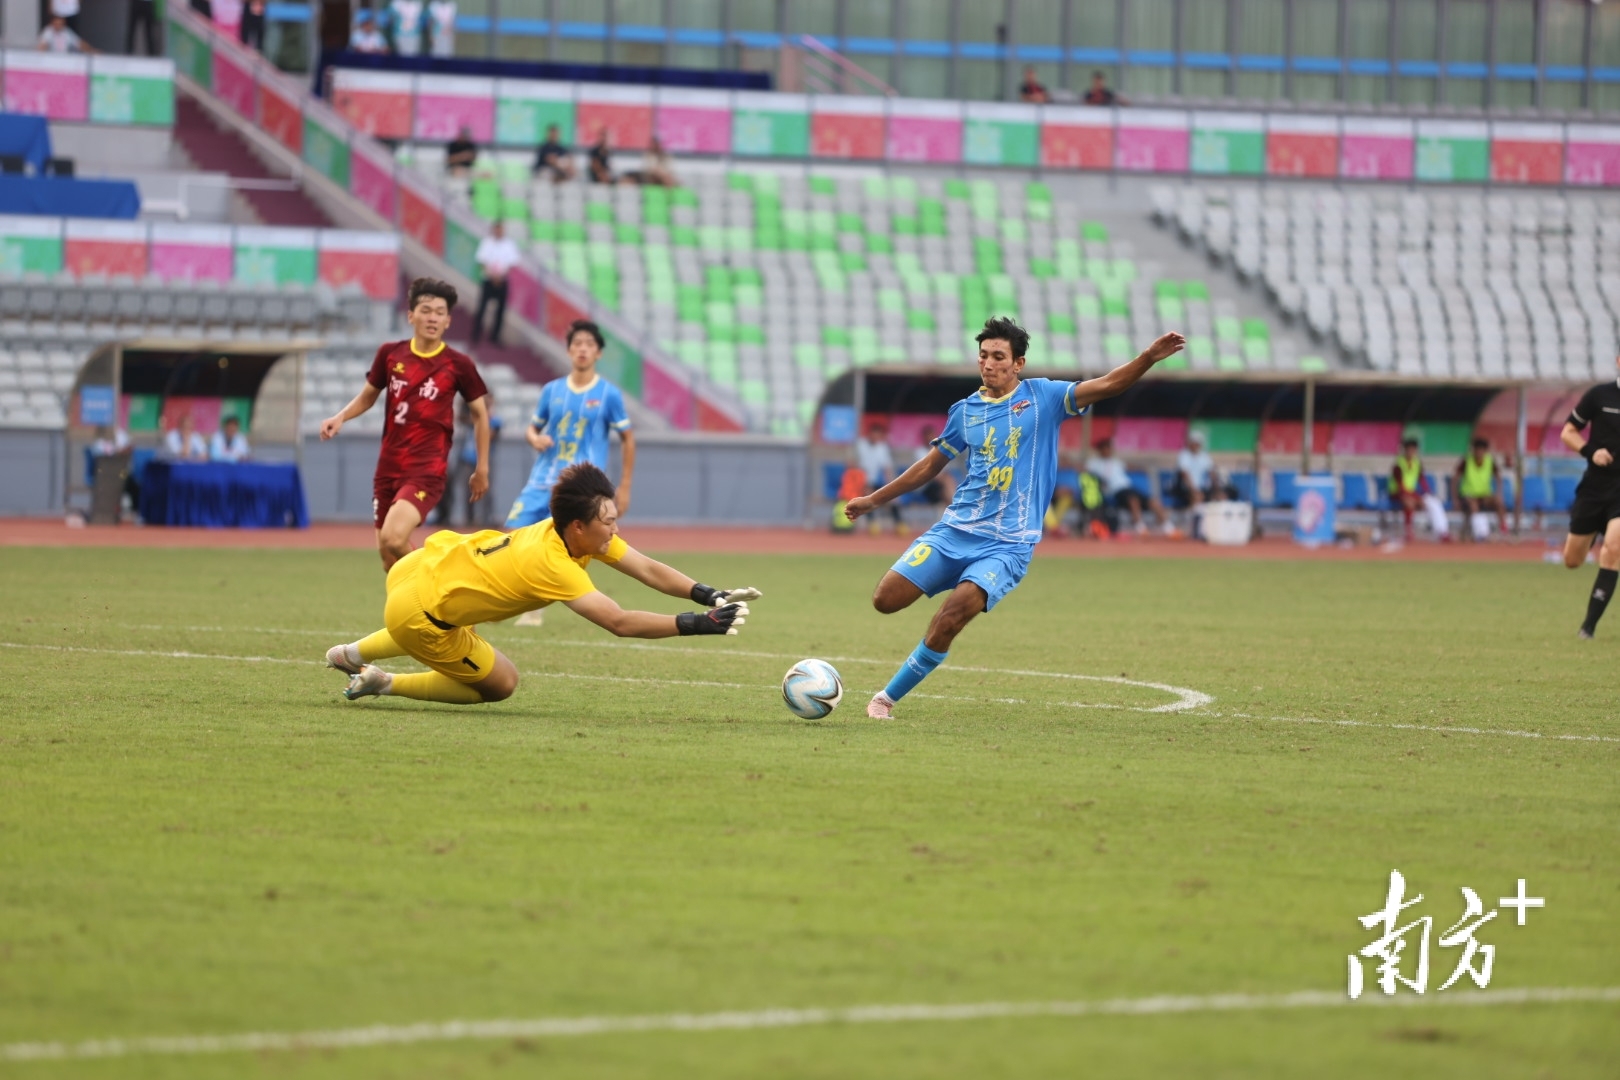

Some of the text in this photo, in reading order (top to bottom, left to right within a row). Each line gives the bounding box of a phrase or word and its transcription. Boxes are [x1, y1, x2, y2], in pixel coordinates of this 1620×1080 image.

[389, 375, 440, 401] 河南
[394, 402, 409, 425] 2
[557, 441, 577, 461] 12
[462, 656, 480, 671] 1
